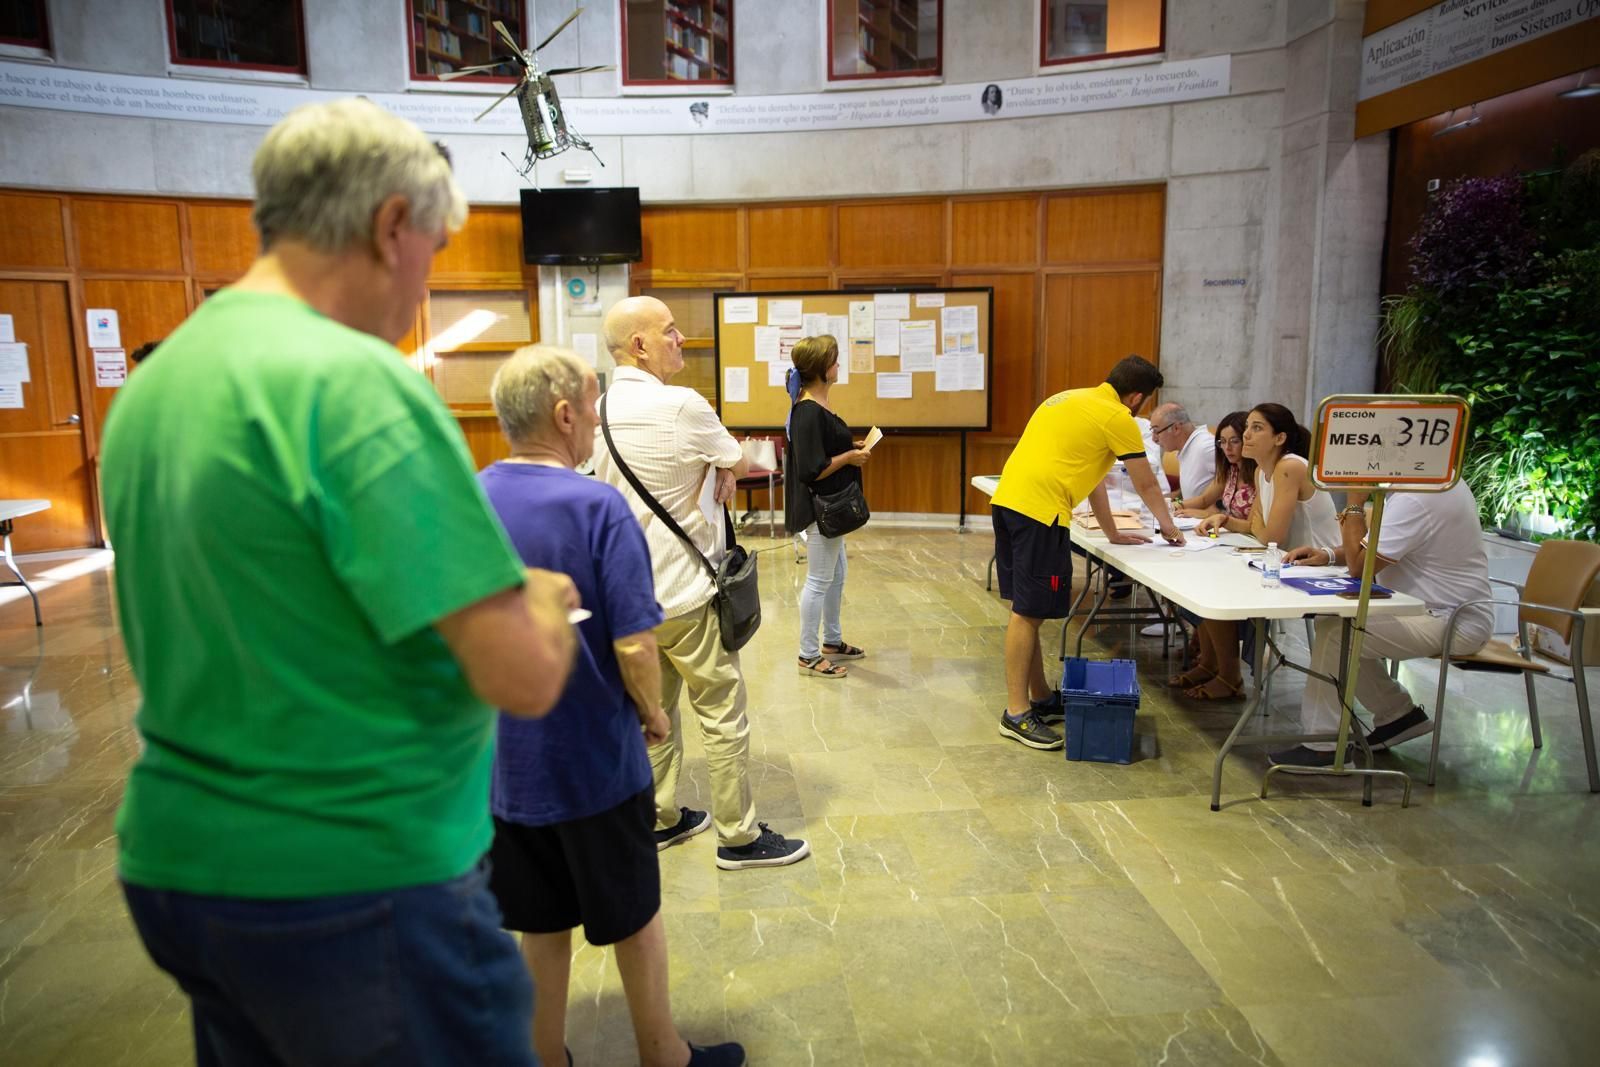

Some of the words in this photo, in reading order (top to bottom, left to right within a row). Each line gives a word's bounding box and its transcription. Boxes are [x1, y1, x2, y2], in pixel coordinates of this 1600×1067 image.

[1519, 8, 1572, 37] Sistema
[1367, 28, 1425, 64] Aplicación
[1491, 32, 1519, 49] Datos
[5, 73, 37, 86] hacer
[40, 77, 50, 87] el
[54, 79, 91, 92] trabajo
[94, 82, 107, 93] de
[110, 85, 160, 96] cincuenta
[162, 88, 206, 101] hombres
[1045, 83, 1054, 93] lo
[1144, 73, 1153, 82] lo
[1156, 68, 1200, 81] recuerdo,
[1070, 93, 1079, 103] lo
[1177, 79, 1219, 92] Franklin
[26, 89, 56, 101] hacer
[60, 92, 70, 102] el
[73, 94, 111, 108] trabajo
[113, 97, 126, 107] de
[129, 100, 142, 108] un
[144, 100, 184, 112] hombre
[928, 94, 938, 103] de
[1332, 410, 1376, 418] SECCIÓN
[1329, 433, 1382, 446] MESA
[1397, 416, 1450, 446] 37B
[1367, 462, 1380, 471] M
[1414, 462, 1425, 471] Z
